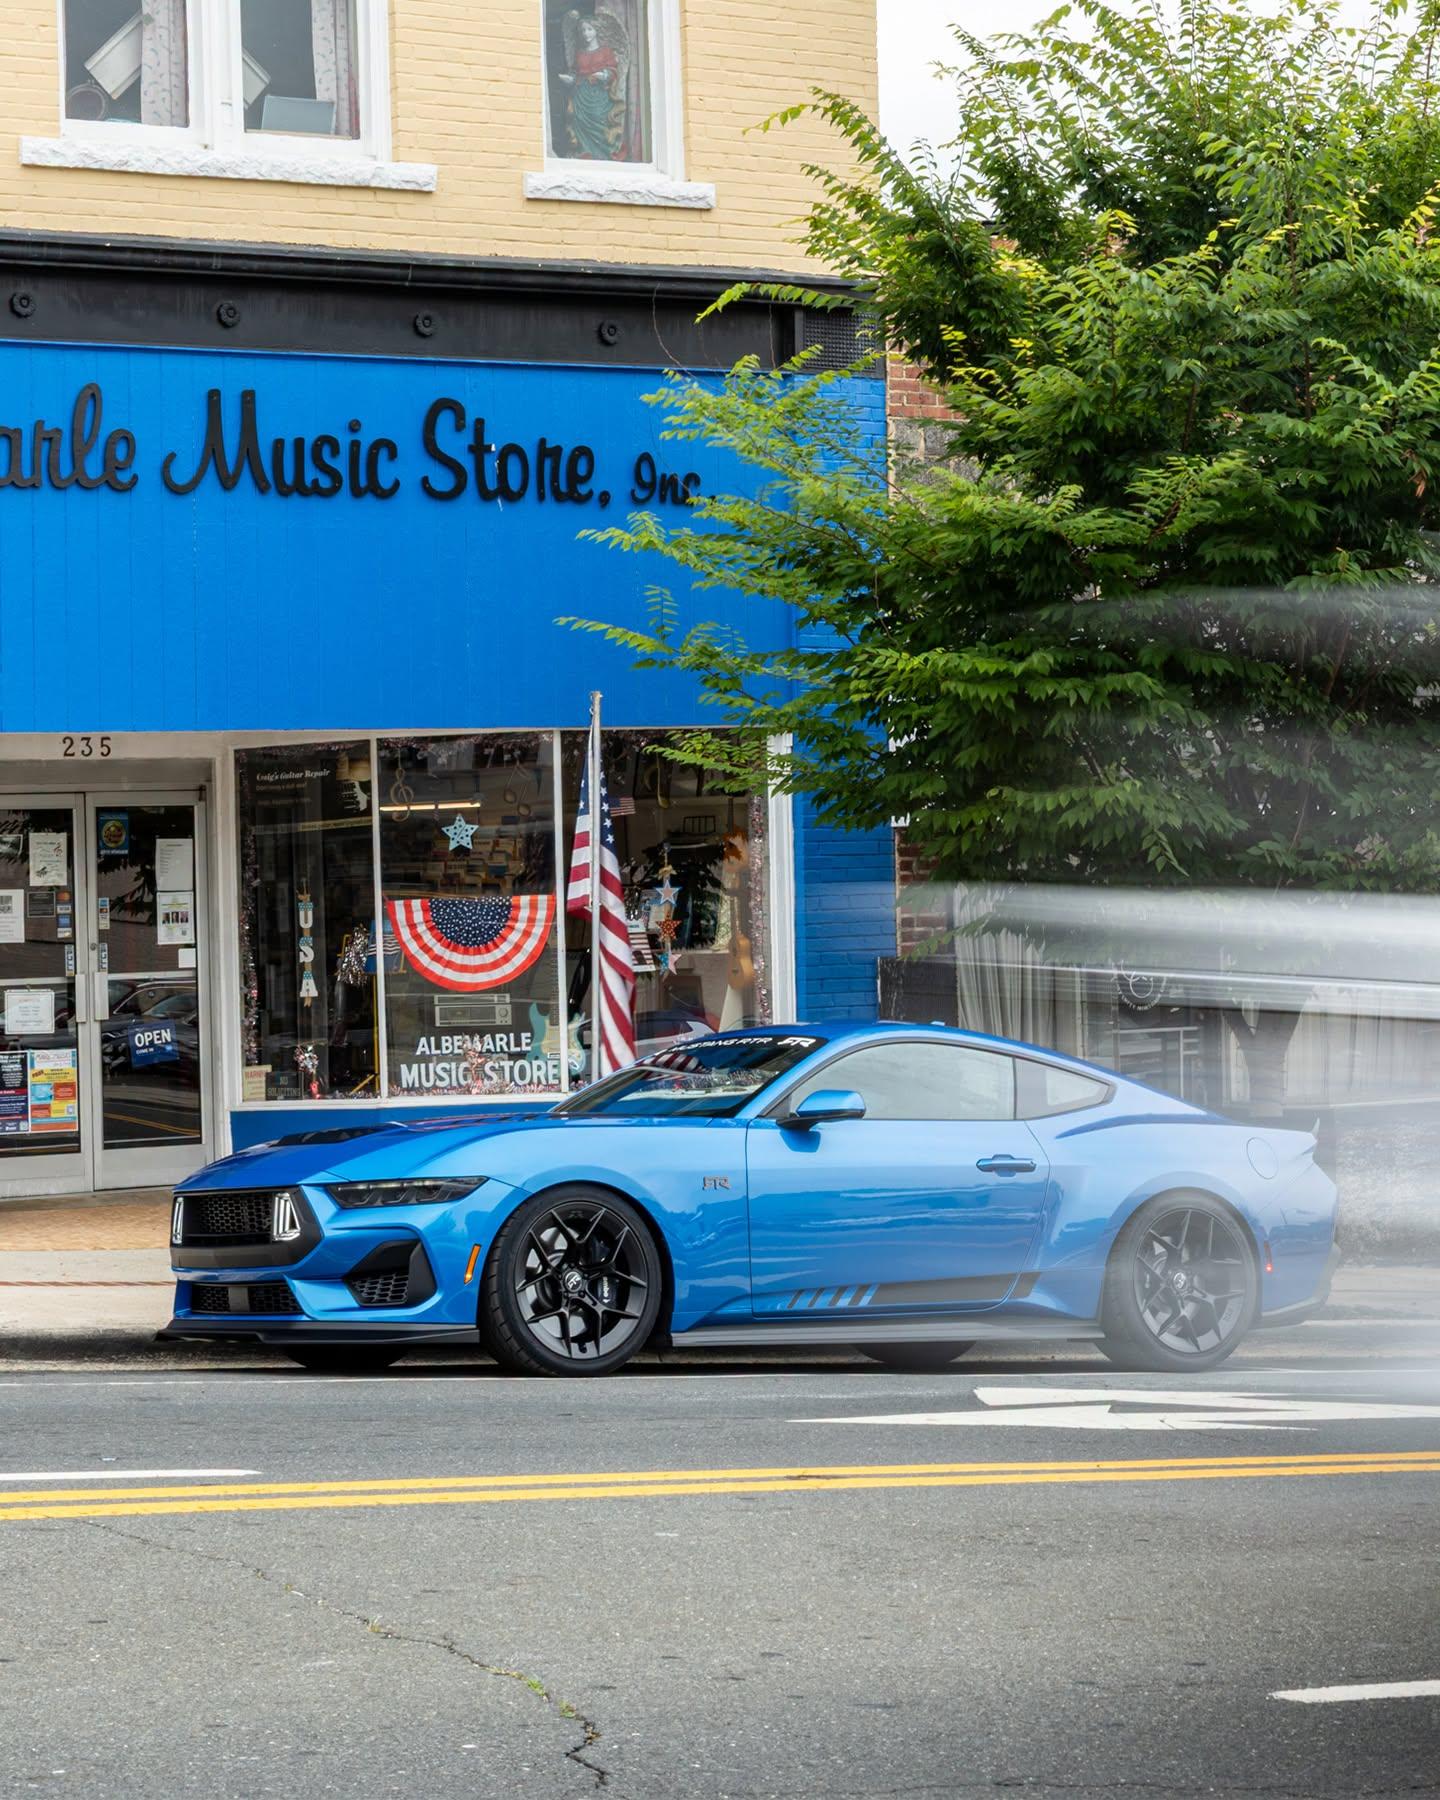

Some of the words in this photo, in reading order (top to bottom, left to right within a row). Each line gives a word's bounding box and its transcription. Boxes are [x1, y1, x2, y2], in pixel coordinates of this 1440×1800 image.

[163, 388, 400, 499] Music
[421, 397, 611, 509] Store,
[62, 736, 112, 757] 235
[280, 771, 304, 780] Guitar
[304, 769, 331, 778] Repair
[134, 1028, 171, 1048] OPEN
[400, 1062, 472, 1089] MUSIC
[483, 1059, 560, 1087] STORE
